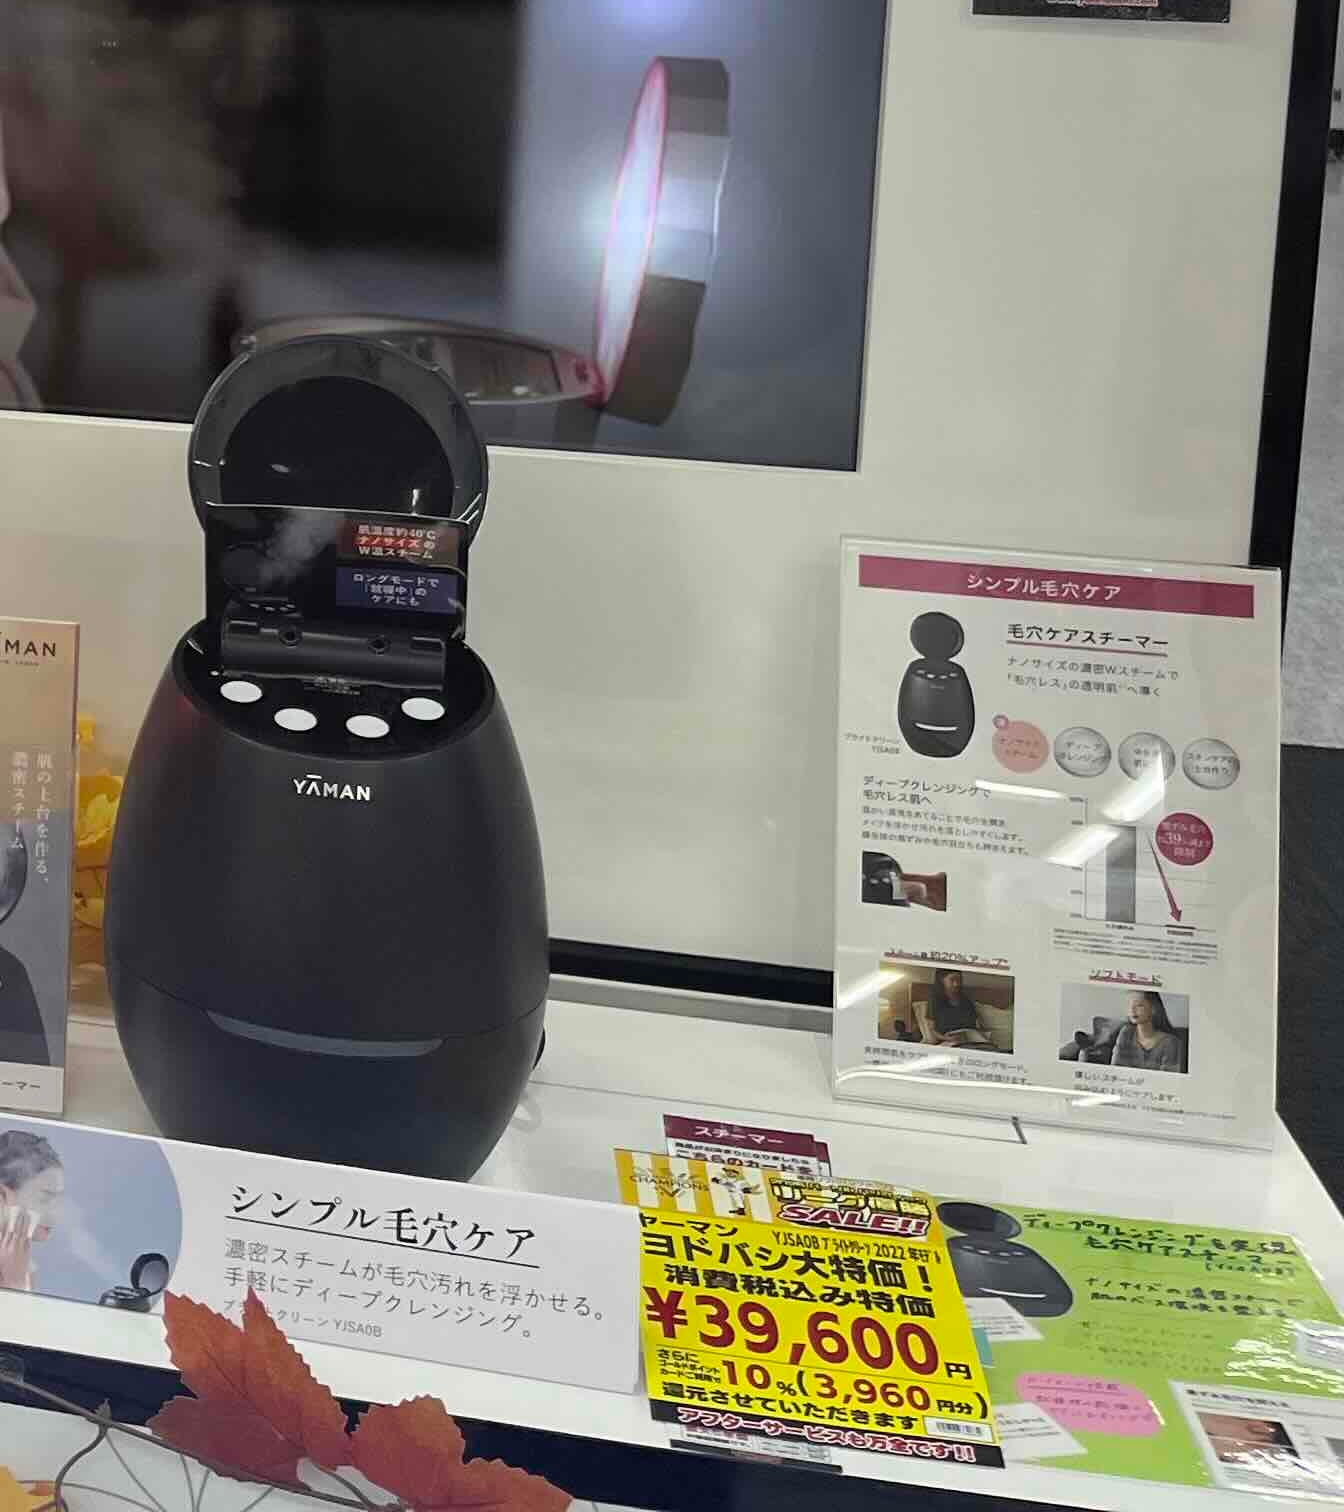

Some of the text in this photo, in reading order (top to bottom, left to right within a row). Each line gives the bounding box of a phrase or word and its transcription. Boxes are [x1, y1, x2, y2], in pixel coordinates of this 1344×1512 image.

[966, 572, 1122, 601] シンプル毛穴ケア
[1006, 622, 1169, 649] 毛穴ケアスチーマー
[231, 1184, 537, 1260] シンプル毛穴ケア
[639, 1211, 739, 1237] ヤーマン
[225, 1237, 605, 1322] 濃密スチームが毛穴汚れを浮かせる。
[642, 1231, 935, 1293] ヨドバシ大特価!
[223, 1267, 535, 1339] 手軽にディープクレンジング。
[663, 1263, 937, 1318] 消費税込み特価
[662, 1381, 919, 1431] 還元させていただきます
